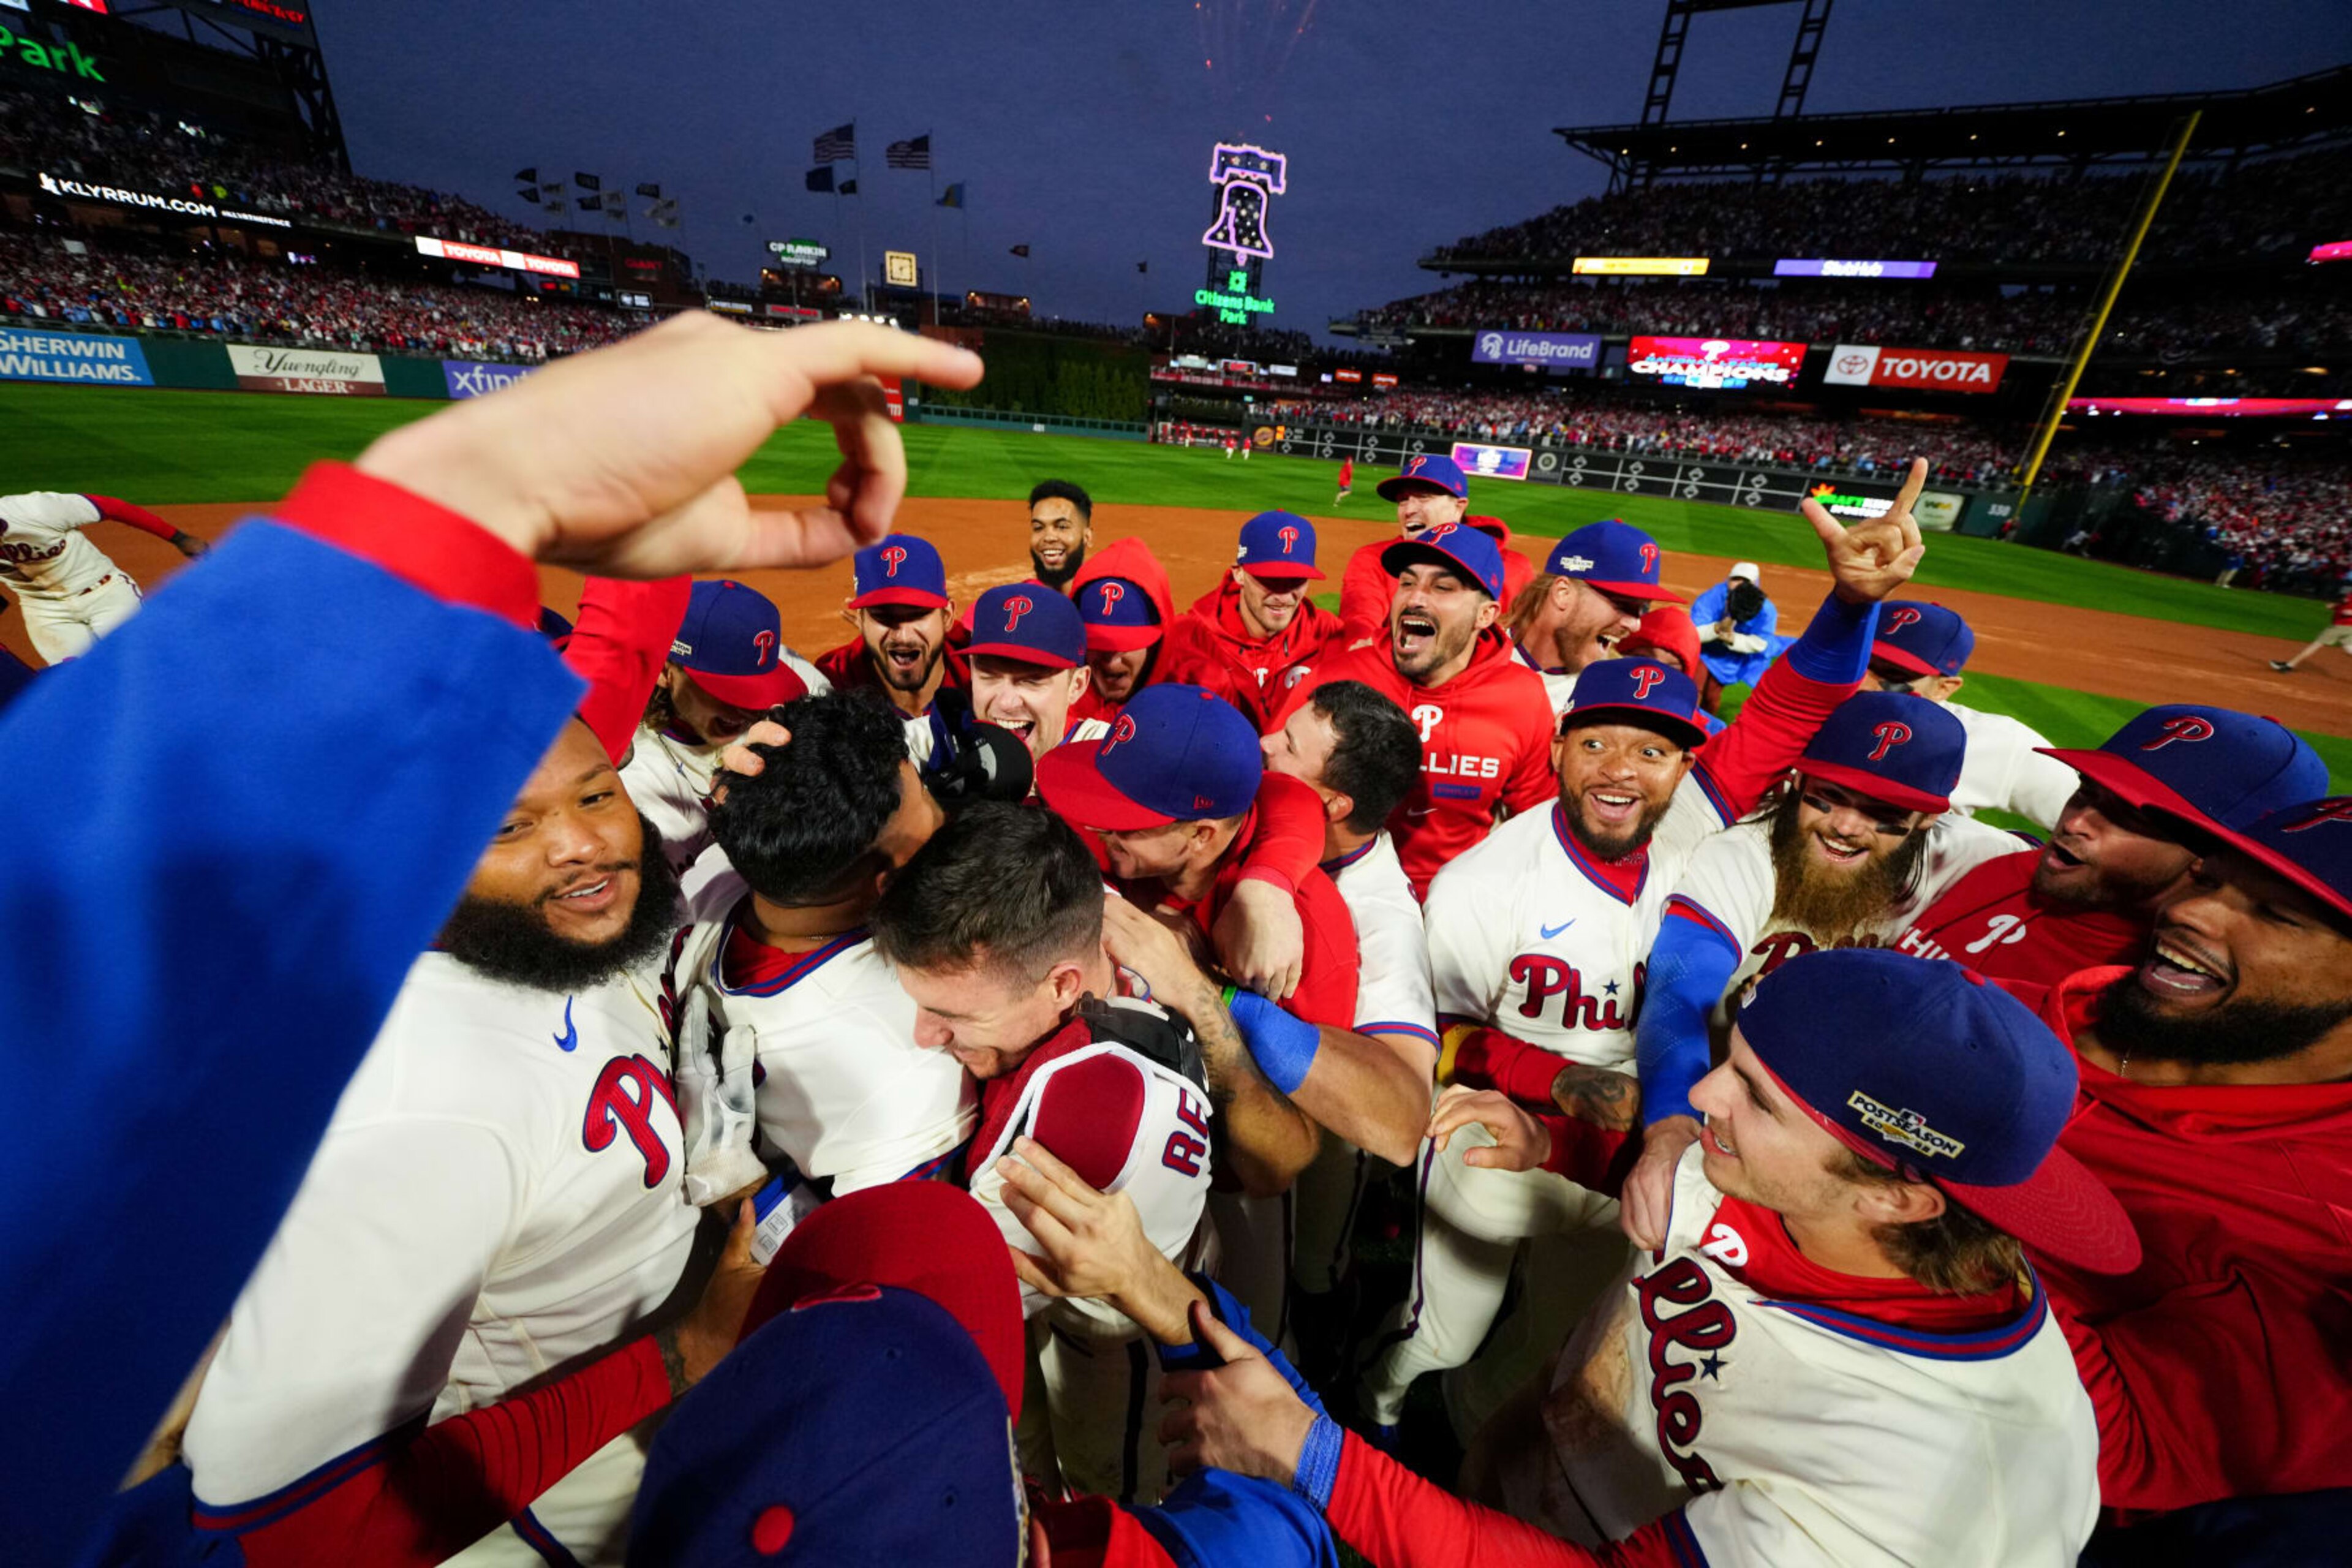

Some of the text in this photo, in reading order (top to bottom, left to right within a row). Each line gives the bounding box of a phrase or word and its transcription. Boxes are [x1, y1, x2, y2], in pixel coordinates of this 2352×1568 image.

[59, 179, 217, 217] KLYRRUM.COM
[445, 244, 502, 263] TOYOTA
[769, 241, 786, 252] CP
[525, 257, 578, 275] TOYOTA
[1196, 289, 1275, 314] Citizens Bank
[1220, 308, 1247, 325] Park
[254, 349, 364, 378] Yuengling
[1506, 339, 1594, 359] LifeBrand
[283, 377, 349, 394] LAGER
[452, 365, 528, 397] xfin
[1631, 361, 1790, 382] CHAMPIONS
[1882, 358, 1991, 383] TOYOTA
[1278, 526, 1299, 554] P
[1428, 522, 1458, 545] P
[881, 545, 907, 577] P
[1640, 543, 1660, 575] P
[1003, 595, 1033, 632] P
[1100, 582, 1124, 616] P
[1885, 608, 1921, 635] P
[753, 630, 775, 666] P
[1630, 665, 1665, 699] P
[1101, 714, 1136, 756] P
[1412, 704, 1443, 742] P
[2142, 715, 2214, 751] P
[1868, 720, 1912, 761] P
[1420, 752, 1500, 778] LIES
[1966, 914, 2026, 953] P
[1509, 953, 1647, 1031] Phil
[1161, 1087, 1208, 1178] RE
[1853, 1095, 1958, 1154] POSTSEASON
[1700, 1223, 1748, 1267] P
